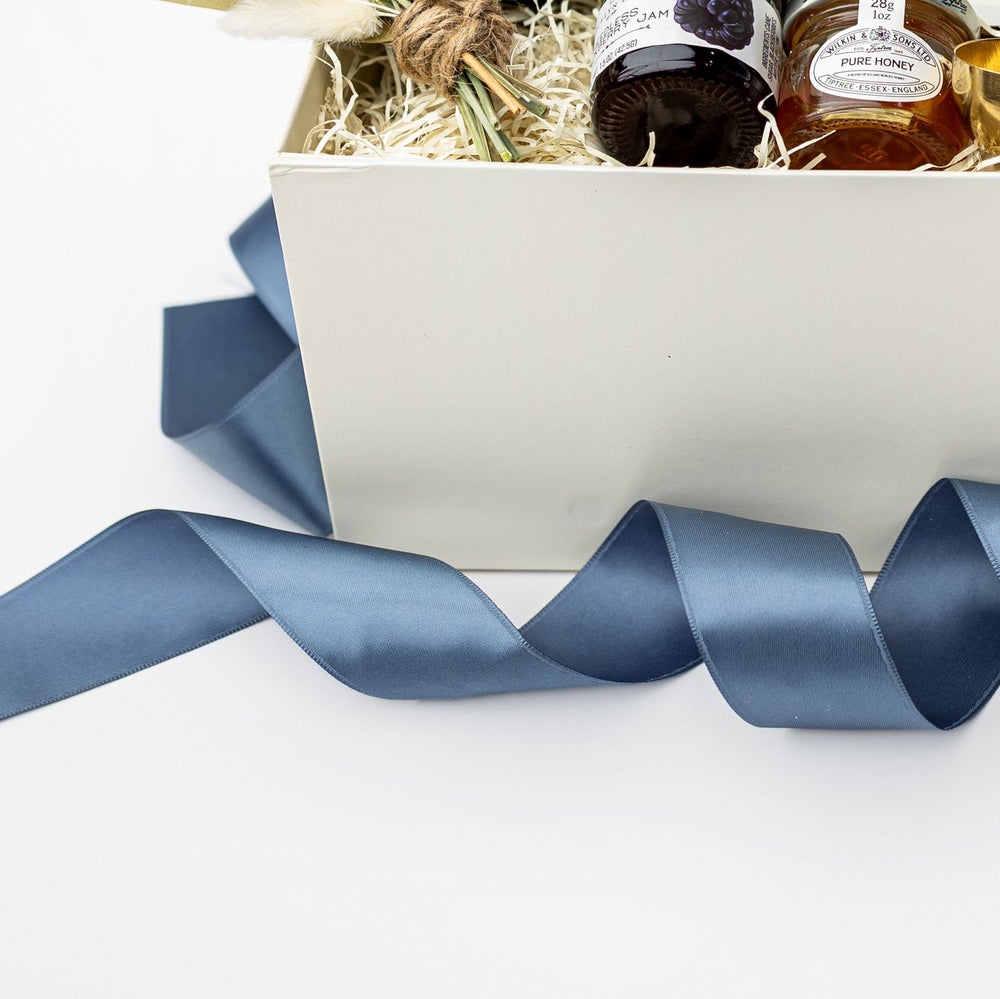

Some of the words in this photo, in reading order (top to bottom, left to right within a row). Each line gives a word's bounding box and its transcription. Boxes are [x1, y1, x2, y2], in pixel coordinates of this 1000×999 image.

[637, 9, 669, 23] JAM
[872, 9, 891, 20] 1oz
[826, 34, 856, 55] WILKIN
[892, 34, 916, 51] SONS
[916, 47, 931, 62] LTD
[841, 57, 872, 67] PURE
[874, 57, 914, 72] HONEY
[825, 77, 856, 90] TIPTREE
[860, 84, 887, 93] ESSEX
[892, 84, 929, 94] ENGLAND
